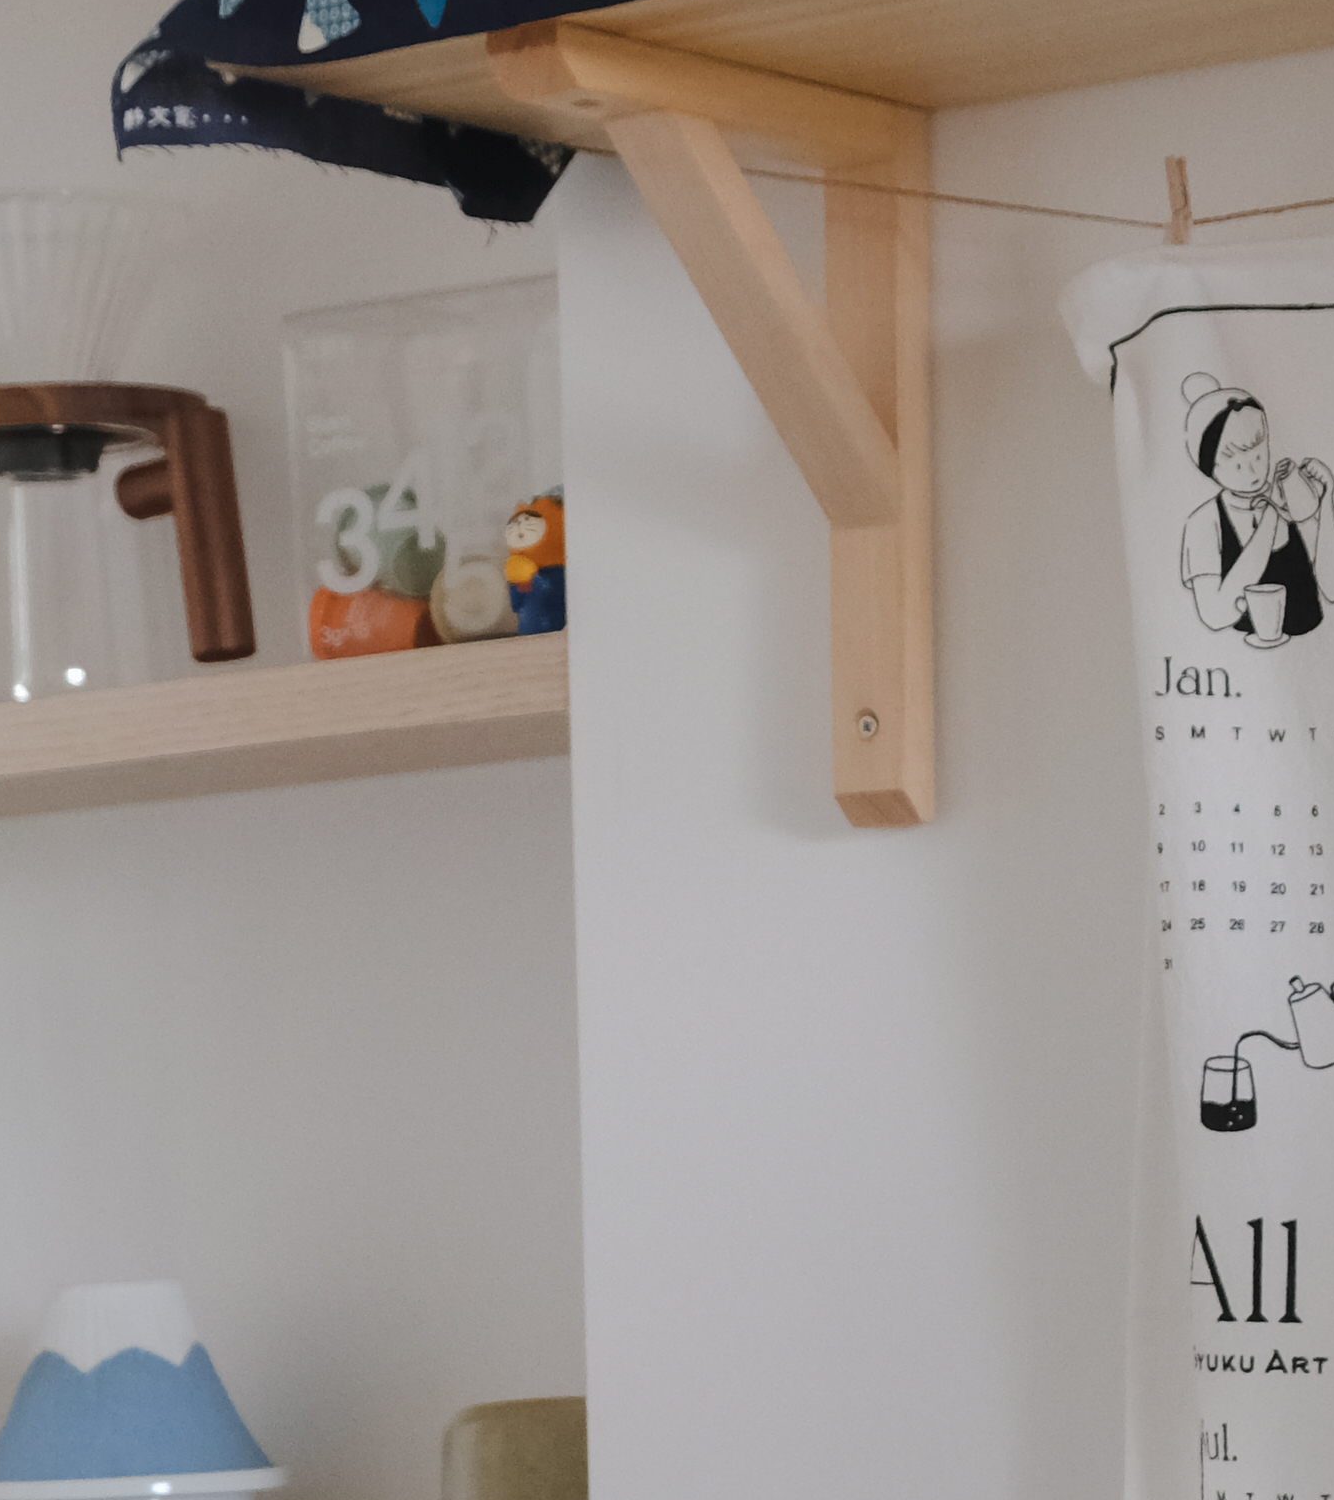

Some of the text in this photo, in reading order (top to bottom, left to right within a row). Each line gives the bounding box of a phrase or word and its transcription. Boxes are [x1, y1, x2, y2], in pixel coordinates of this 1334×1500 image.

[1155, 656, 1242, 698] Jan.
[1155, 726, 1165, 741] S
[1191, 725, 1206, 739] M
[1232, 727, 1242, 740] T
[1269, 729, 1285, 742] W
[1309, 727, 1316, 741] T
[1190, 1214, 1303, 1324] All
[1264, 1349, 1329, 1375] ART
